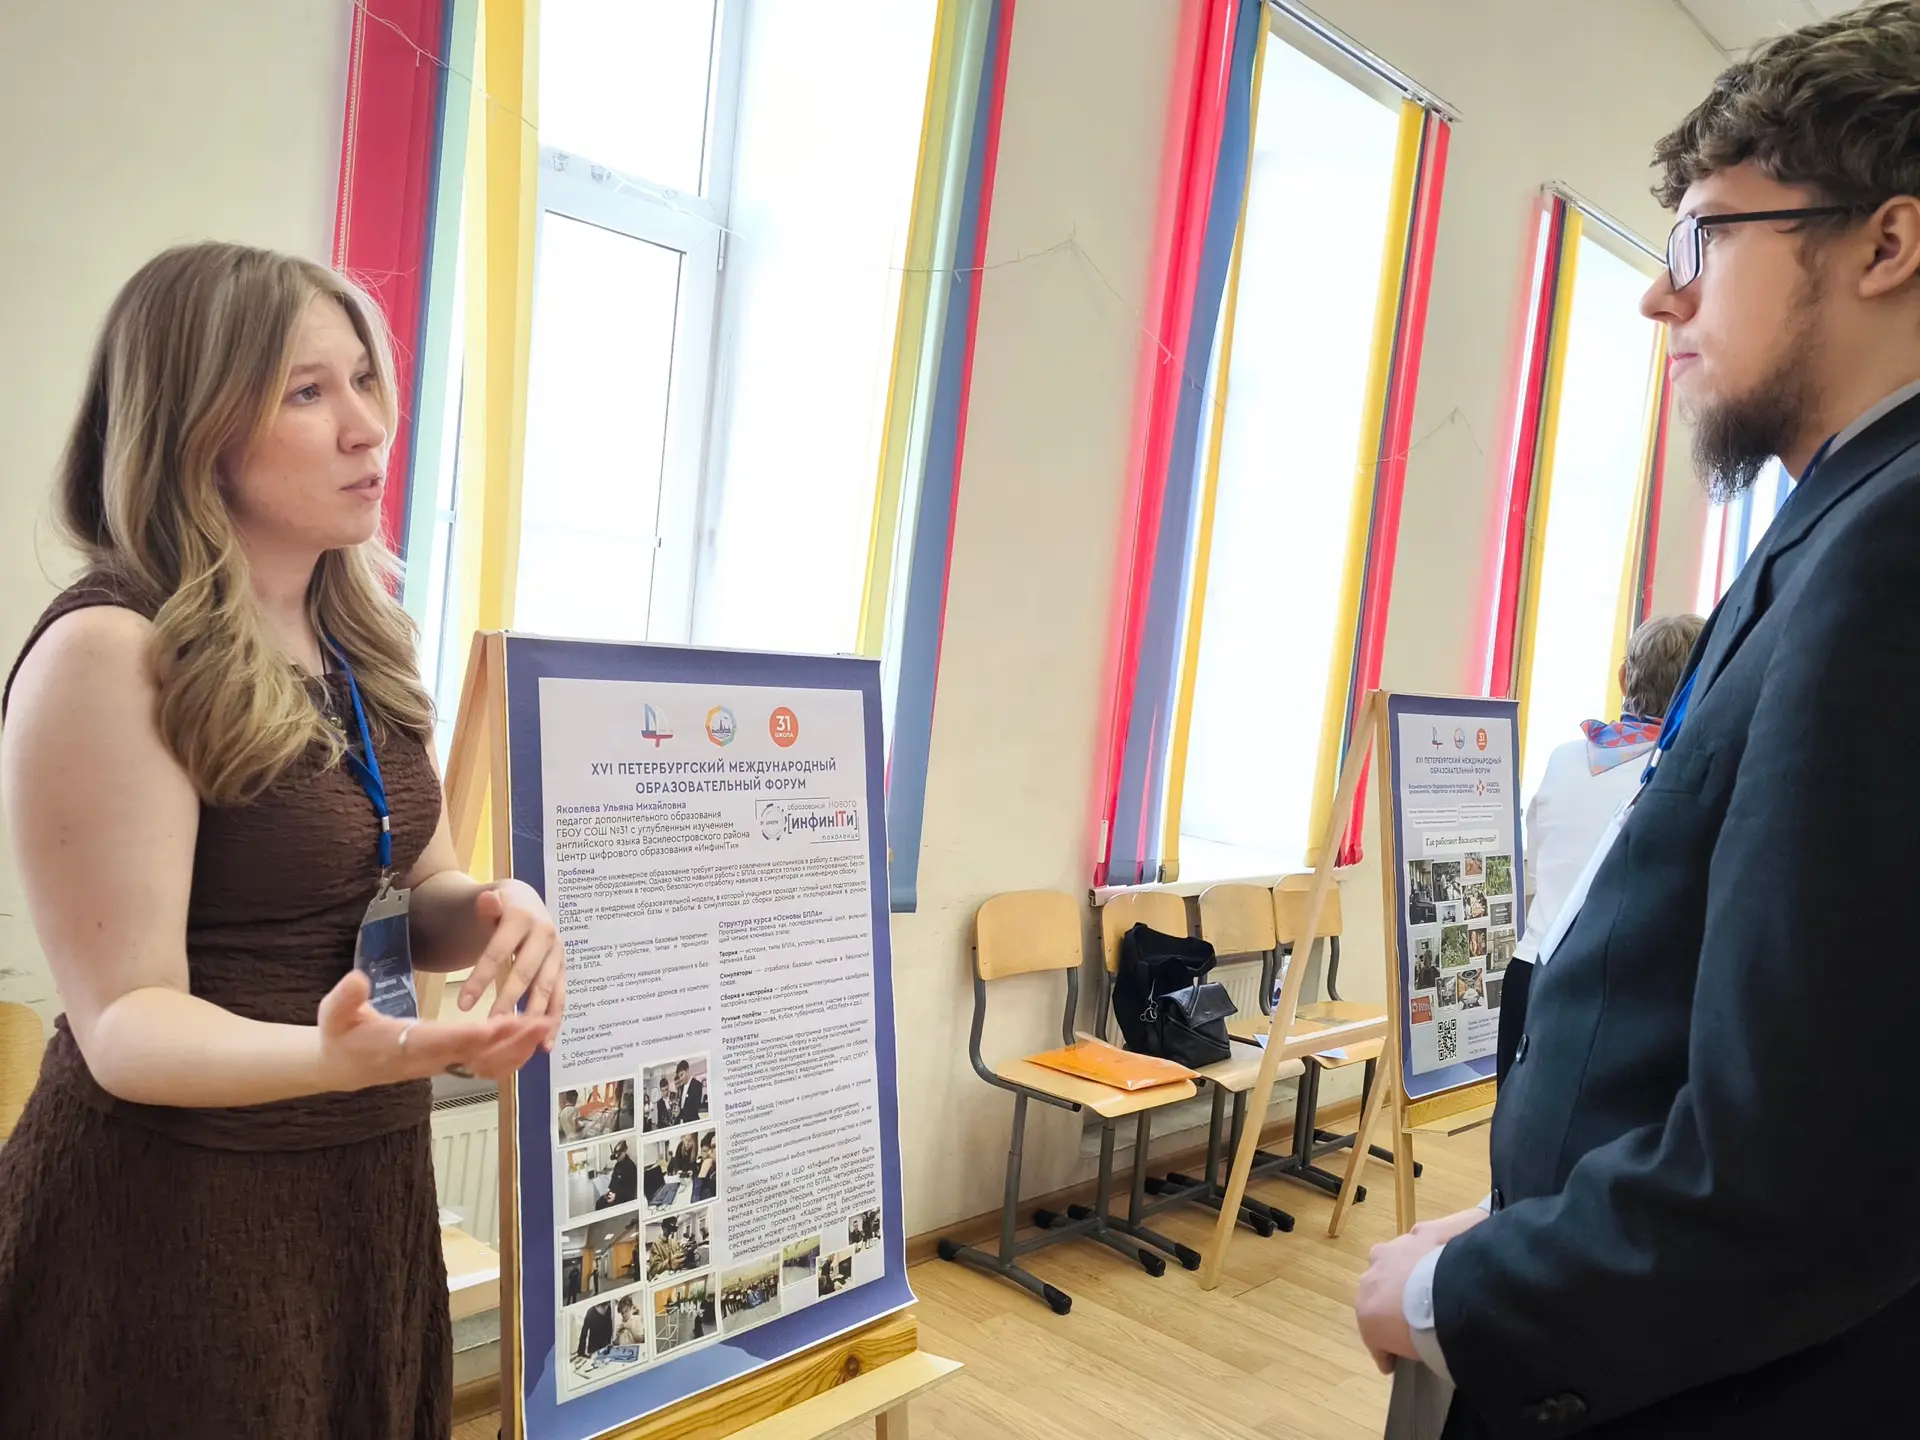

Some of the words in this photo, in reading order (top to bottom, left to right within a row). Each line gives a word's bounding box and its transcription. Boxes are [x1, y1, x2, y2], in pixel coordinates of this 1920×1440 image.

[775, 715, 791, 731] 31
[591, 763, 612, 775] XVI
[618, 759, 724, 774] ПЕТЕРБУРГСКИЙ
[729, 757, 836, 773] МЕЖДУНАРОДНЫЙ
[636, 776, 761, 793] ОБРАЗОВАТЕЛЬНЫЙ
[765, 777, 806, 789] ФОРУМ
[556, 805, 600, 813] Яковлева
[603, 803, 633, 811] Ульяна
[636, 800, 686, 810] Михайловна
[556, 817, 591, 826] педагог
[595, 814, 668, 825] дополнительного
[670, 810, 721, 821] образования
[556, 828, 581, 837] ГБОУ
[584, 826, 607, 836] СОШ
[610, 825, 627, 834] №31
[638, 823, 690, 835] углубленным
[693, 822, 733, 832] изучением
[556, 838, 613, 849] английского
[616, 838, 640, 846] языка
[642, 833, 721, 844] Василеостровского
[723, 829, 750, 841] района
[556, 852, 586, 862] Центр
[589, 849, 637, 860] цифрового
[640, 846, 692, 857] образования
[557, 868, 594, 878] Проблема
[558, 876, 607, 885] Современное
[608, 872, 647, 880] инженерное
[649, 869, 689, 878] образование
[690, 866, 713, 875] требует
[714, 865, 737, 873] раннего
[810, 856, 828, 865] работу
[649, 877, 671, 885] Однако
[714, 871, 735, 880] работы
[594, 888, 633, 897] погружения
[666, 882, 703, 890] безопасную
[705, 879, 734, 887] отработку
[764, 873, 799, 882] симуляторах
[559, 908, 593, 916] Создание
[601, 904, 635, 912] внедрение
[637, 897, 690, 909] образовательной
[721, 891, 744, 900] которой
[745, 890, 771, 898] учащиеся
[772, 887, 797, 895] проходят
[799, 883, 818, 891] полный
[832, 881, 860, 889] подготовки
[596, 909, 644, 920] теоретической
[672, 905, 694, 913] работы
[704, 900, 739, 909] симуляторах
[774, 894, 794, 903] дронов
[803, 889, 842, 898] пилотирования
[718, 919, 752, 928] Структура
[753, 917, 771, 925] курса
[802, 910, 822, 918] БПЛА»
[559, 924, 590, 932] режиме.
[564, 939, 588, 947] адачи
[567, 976, 605, 986] Обеспечить
[606, 972, 636, 981] отработку
[638, 968, 660, 976] навыков
[662, 964, 693, 974] управления
[719, 969, 752, 979] Симуляторы
[589, 984, 607, 992] среде
[746, 987, 772, 996] настройка
[568, 1001, 595, 1010] Обучить
[597, 997, 619, 1005] сборке
[626, 991, 655, 1001] настройке
[657, 988, 677, 997] дронов
[721, 1014, 740, 1022] Ручные
[742, 1010, 761, 1018] полёты
[571, 1025, 595, 1033] Развить
[598, 1018, 639, 1030] практические
[561, 1035, 585, 1044] ручном
[722, 1033, 758, 1044] Результаты
[725, 1100, 752, 1110] Выводы
[726, 1185, 744, 1193] Опыт
[746, 1178, 767, 1187] школы
[842, 1150, 859, 1159] может
[727, 1183, 778, 1202] масштабирован
[793, 1172, 815, 1182] готовая
[817, 1165, 838, 1175] модель
[840, 1154, 874, 1169] организации
[727, 1195, 762, 1211] кружковой
[764, 1183, 805, 1201] деятельности
[728, 1219, 751, 1231] ручное
[802, 1190, 842, 1206] соответствует
[756, 1199, 787, 1212] структура
[771, 1214, 795, 1226] проекта
[787, 1218, 811, 1229] служить
[814, 1208, 838, 1220] основой
